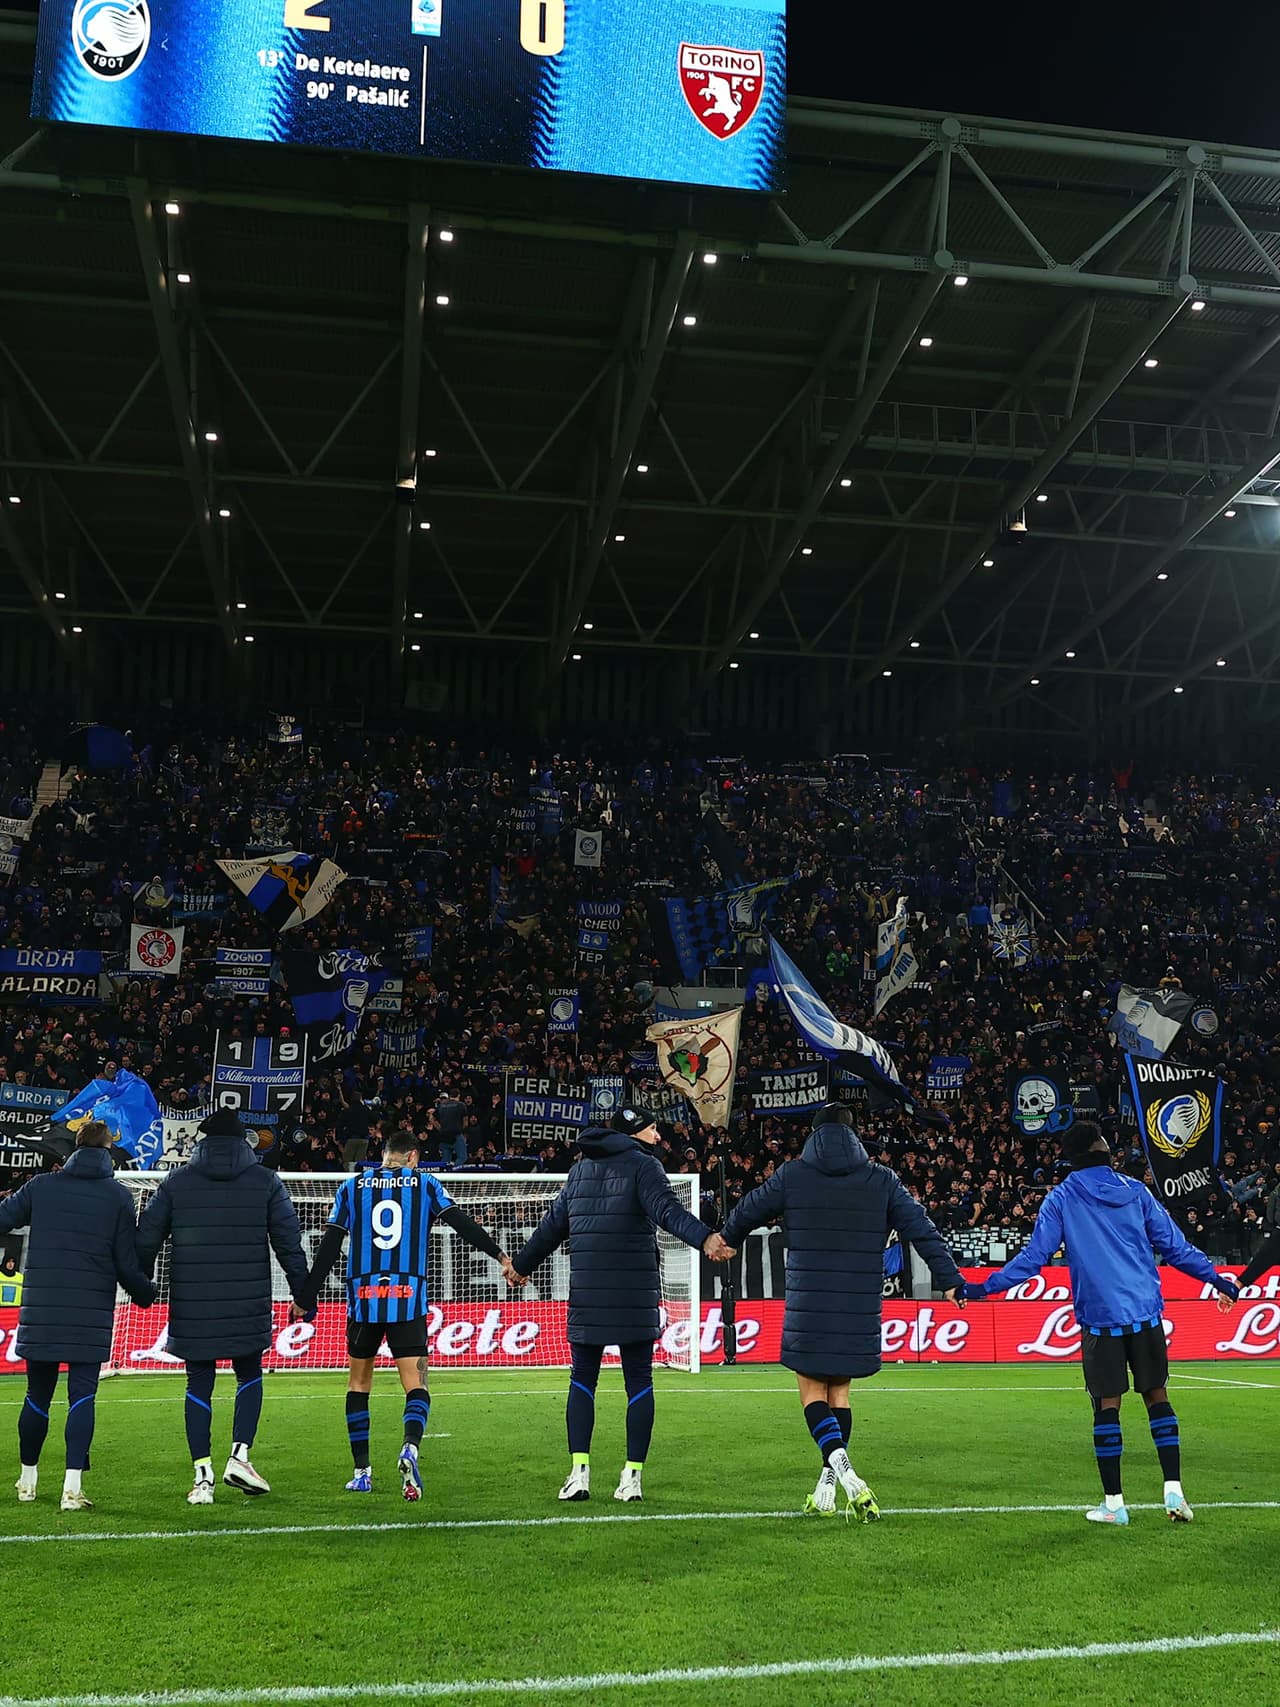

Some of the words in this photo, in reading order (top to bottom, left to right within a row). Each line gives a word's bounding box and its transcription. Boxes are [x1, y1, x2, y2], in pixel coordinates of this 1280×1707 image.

[92, 54, 124, 69] 1907
[257, 50, 284, 67] 13'
[296, 53, 320, 72] De
[323, 57, 410, 82] Ketelaere
[688, 51, 755, 71] TORINO
[686, 71, 705, 80] 1906
[731, 76, 755, 92] FC
[307, 82, 335, 100] 90'
[347, 85, 409, 108] Pašalić
[16, 950, 75, 967] ORDA
[223, 952, 264, 962] ZOGNO
[548, 987, 579, 996] ULTRAS
[514, 1077, 550, 1095] PER
[556, 1083, 586, 1099] CHI
[760, 1071, 818, 1091] TANTO
[927, 1073, 964, 1087] STUPE
[16, 1090, 52, 1106] ORDA
[751, 1085, 827, 1109] TORNANO
[926, 1088, 961, 1100] FATTI
[513, 1100, 545, 1116] NON
[550, 1103, 583, 1121] PUÒ
[357, 1176, 418, 1189] SCAMACCA
[371, 1199, 402, 1250] 9
[652, 1305, 761, 1354] ete
